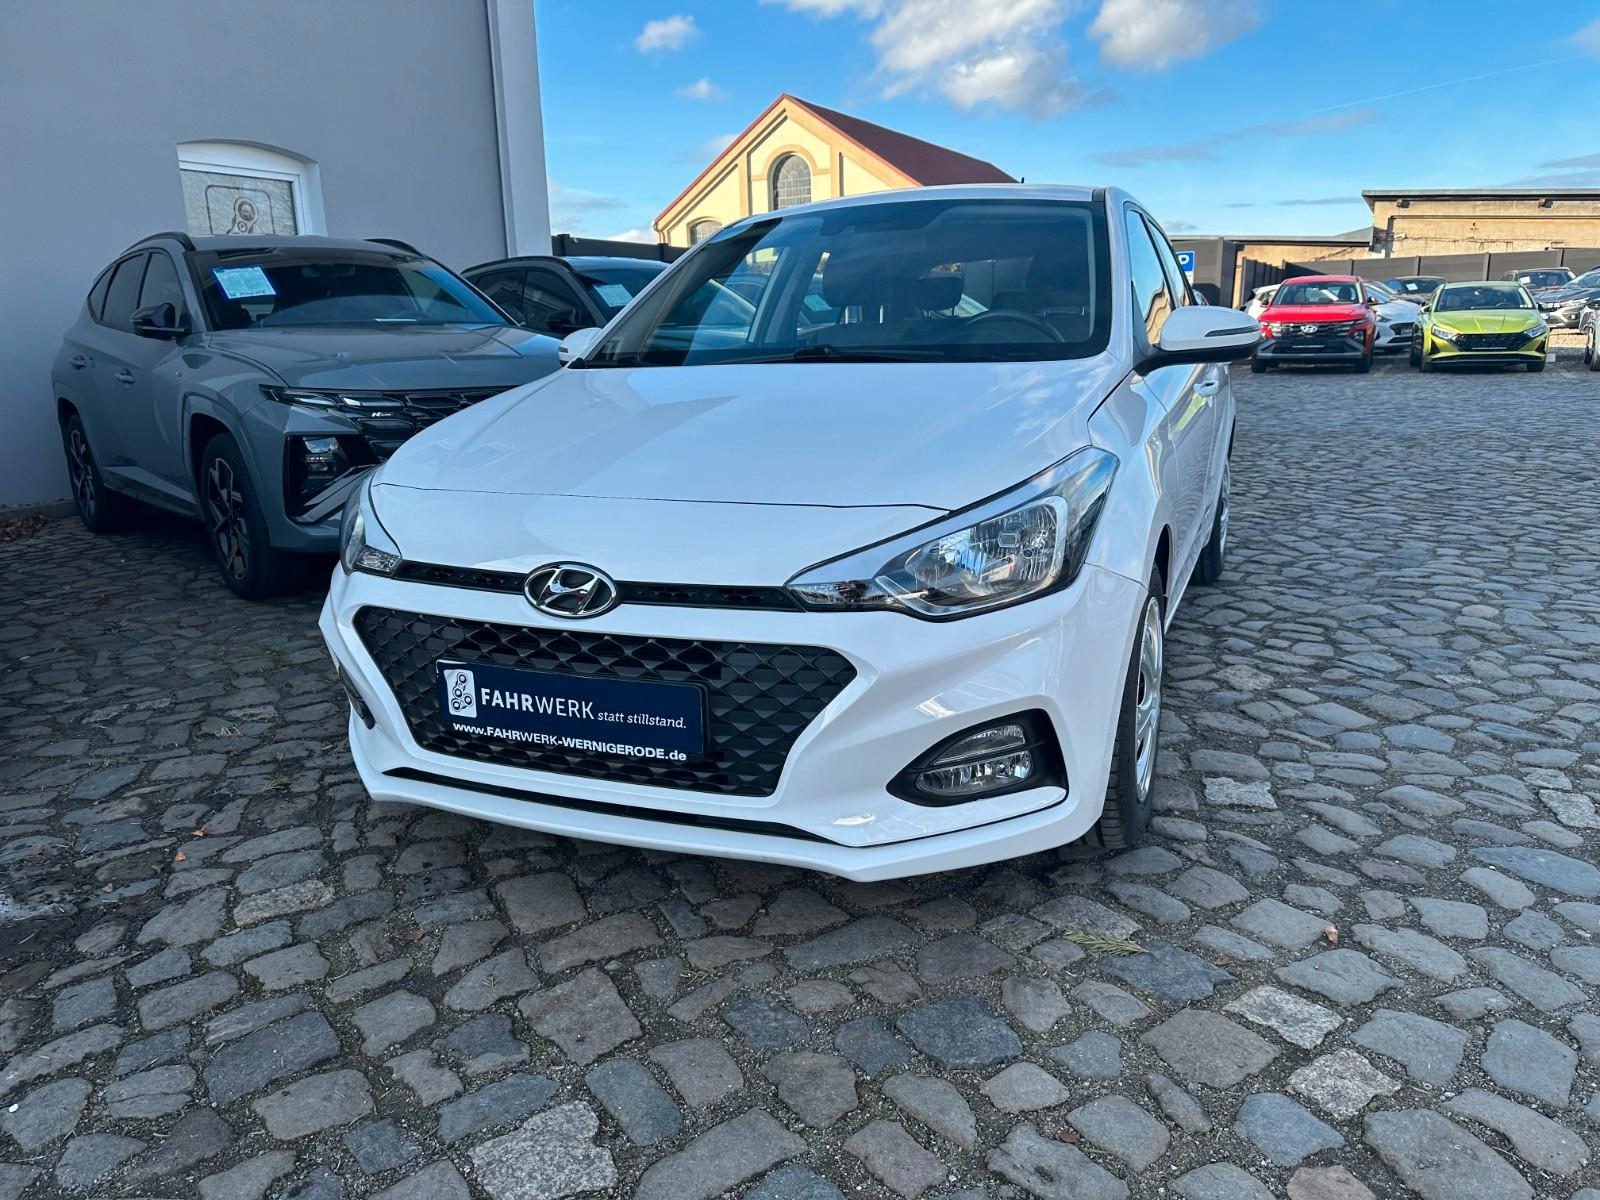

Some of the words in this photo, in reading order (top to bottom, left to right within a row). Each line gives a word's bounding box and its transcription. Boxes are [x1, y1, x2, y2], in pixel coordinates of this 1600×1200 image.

[480, 687, 595, 720] FAHRWERK
[597, 711, 625, 723] statt
[626, 713, 687, 729] stillstand.
[452, 722, 687, 761] www.FAHRWERK-WERNIGERODE.de
